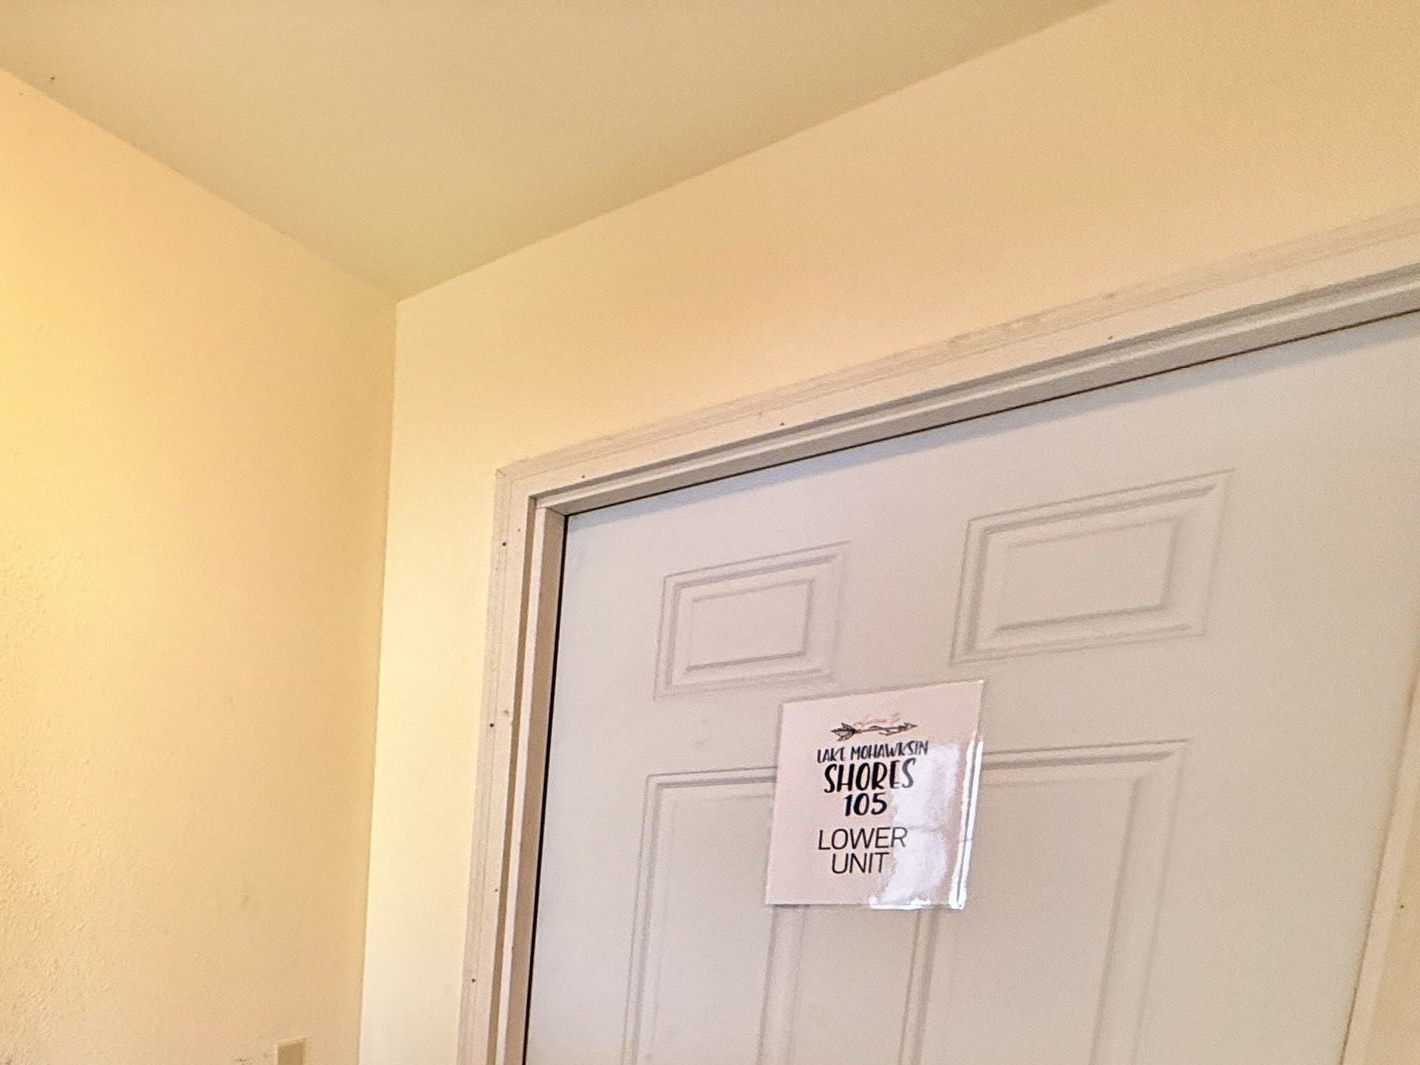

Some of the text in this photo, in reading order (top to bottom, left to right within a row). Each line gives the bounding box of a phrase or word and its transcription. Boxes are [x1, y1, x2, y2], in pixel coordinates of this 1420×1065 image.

[817, 740, 929, 763] LAKE MOHAWKSIN
[824, 758, 916, 793] SHORES
[844, 793, 887, 816] 105
[818, 827, 908, 850] LOWER
[831, 852, 890, 874] UNIT
